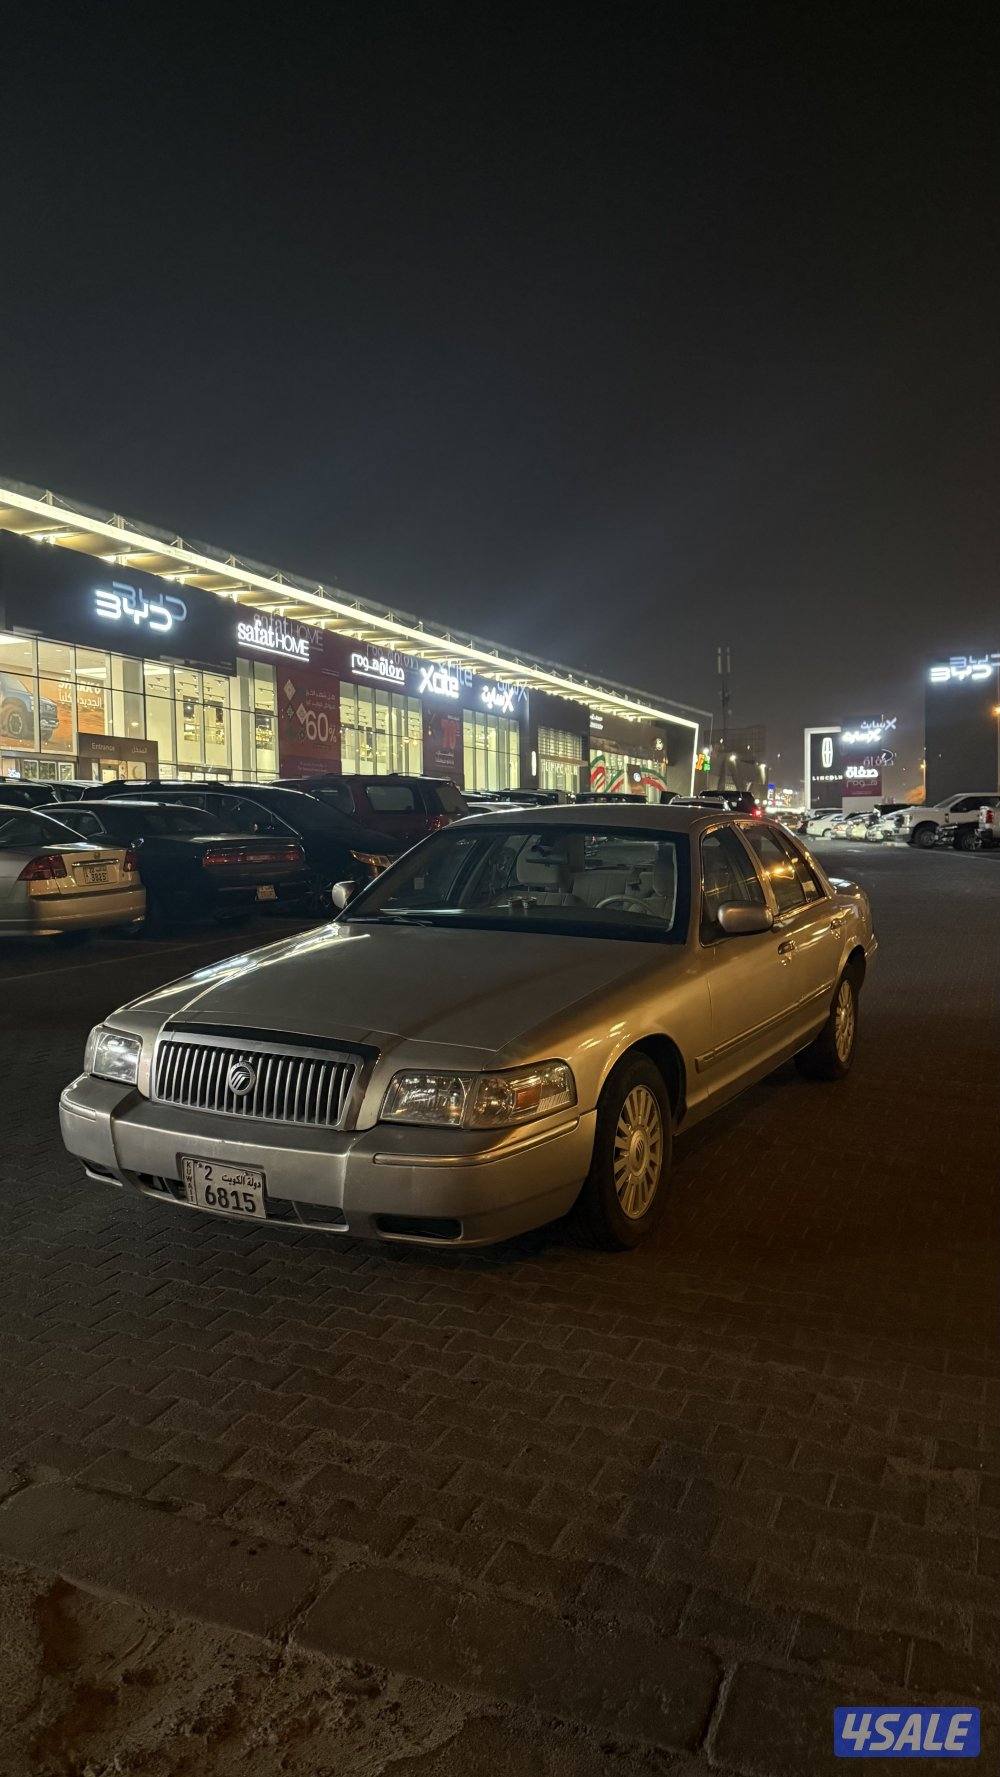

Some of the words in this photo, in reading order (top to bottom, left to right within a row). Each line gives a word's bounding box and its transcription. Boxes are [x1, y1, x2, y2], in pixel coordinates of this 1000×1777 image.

[94, 588, 173, 633] BYD
[929, 664, 993, 683] BYD
[186, 1160, 194, 1202] KUWAIT
[204, 1165, 213, 1181] 2
[221, 1174, 246, 1186] الكويت
[247, 1176, 262, 1190] دولة
[204, 1184, 256, 1213] 6815
